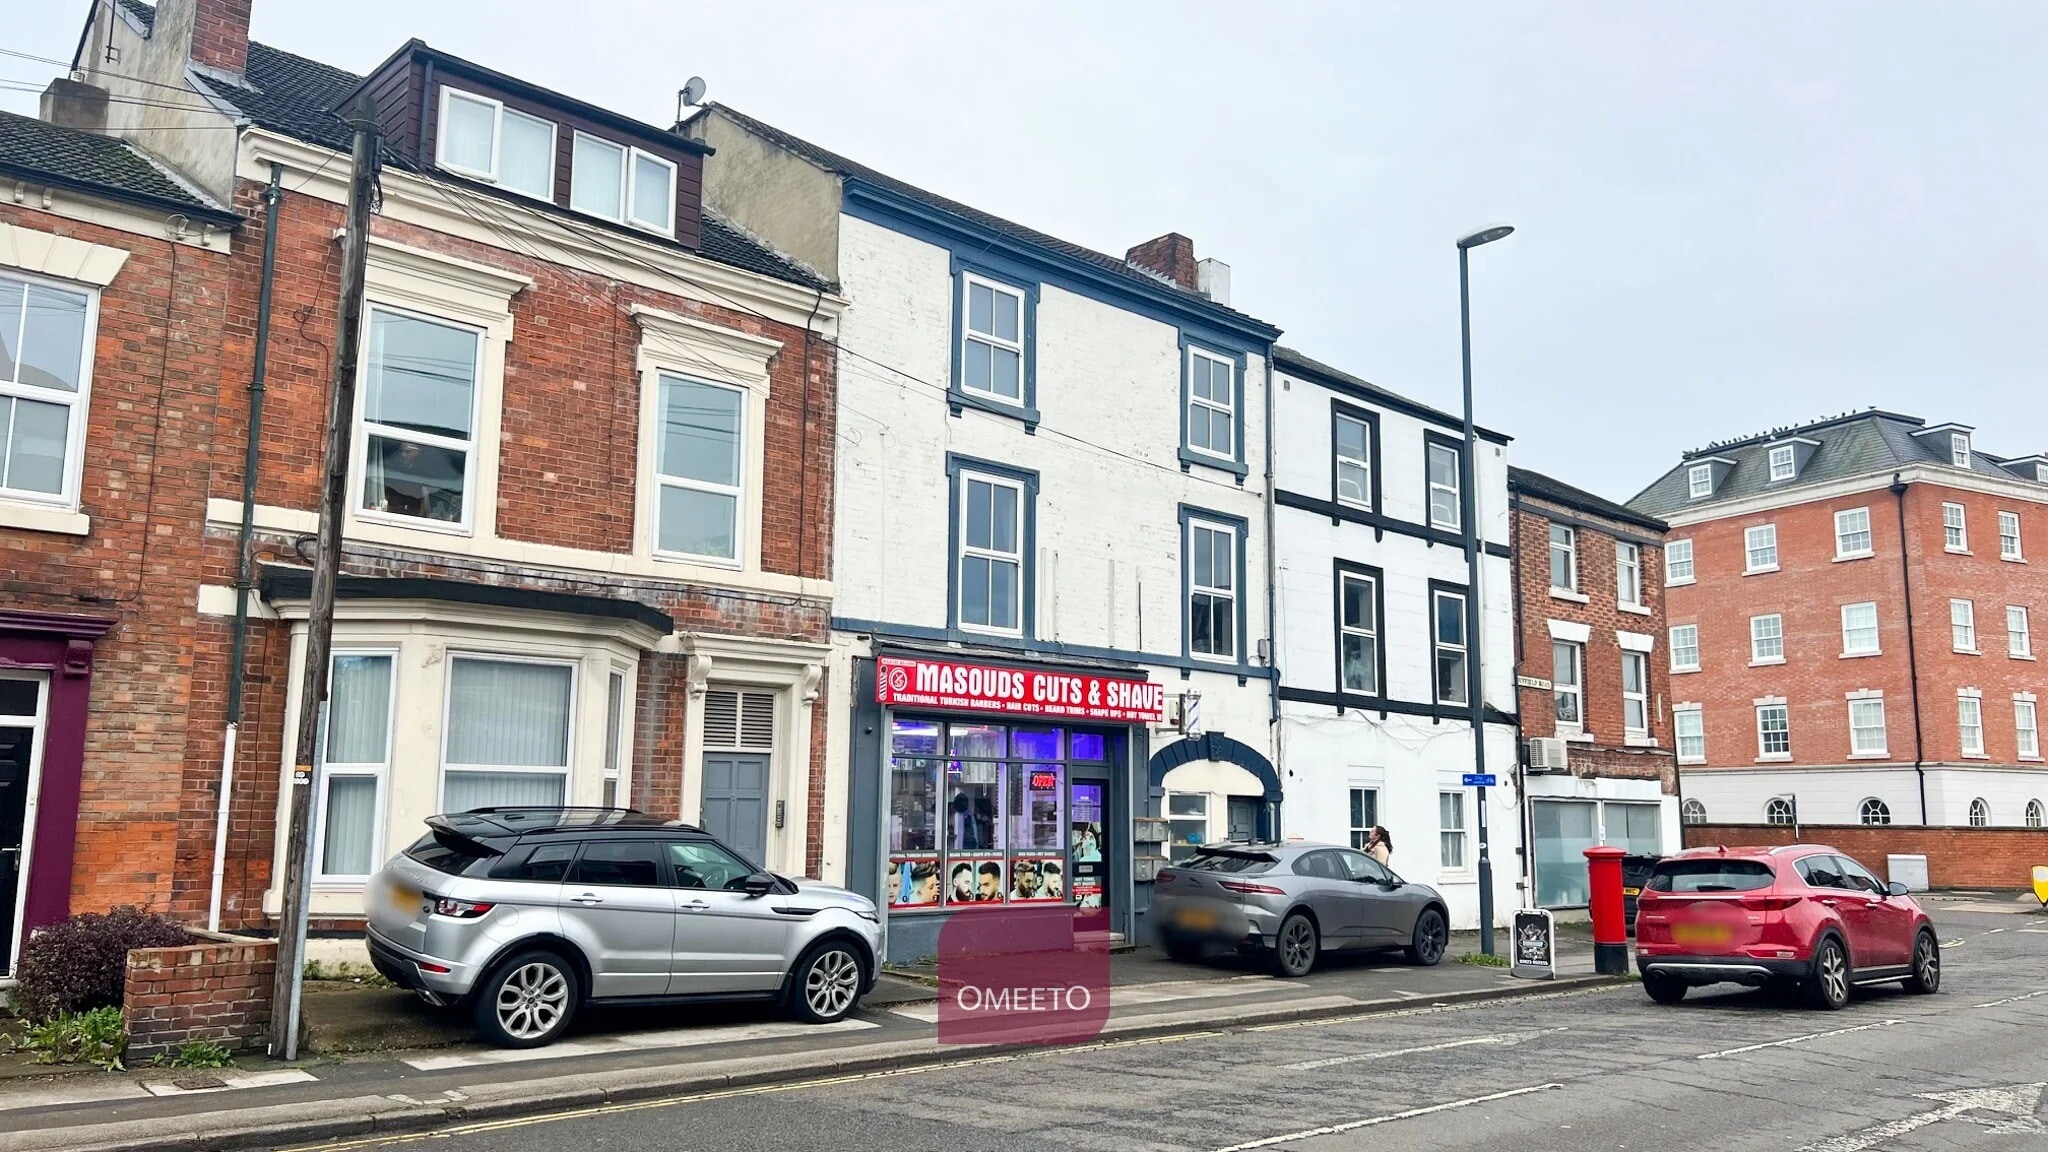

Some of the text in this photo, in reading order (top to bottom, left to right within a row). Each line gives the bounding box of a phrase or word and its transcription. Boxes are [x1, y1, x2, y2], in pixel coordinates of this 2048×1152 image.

[916, 663, 1162, 710] MASOUDS CUTS & SHAVE
[893, 693, 938, 704] TRADITIONAL
[940, 697, 969, 707] TURKISH
[970, 699, 1001, 709] BARBERS
[1006, 702, 1022, 710] HAIR
[1023, 703, 1040, 712] CUTS
[1045, 704, 1066, 714] BEARD
[1066, 706, 1086, 715] TRIMS
[1090, 708, 1109, 717] SHAPE
[1110, 709, 1122, 718] UPS
[1126, 711, 1137, 719] HOT
[1138, 712, 1156, 720] TOWEL
[1032, 774, 1055, 787] OPEN
